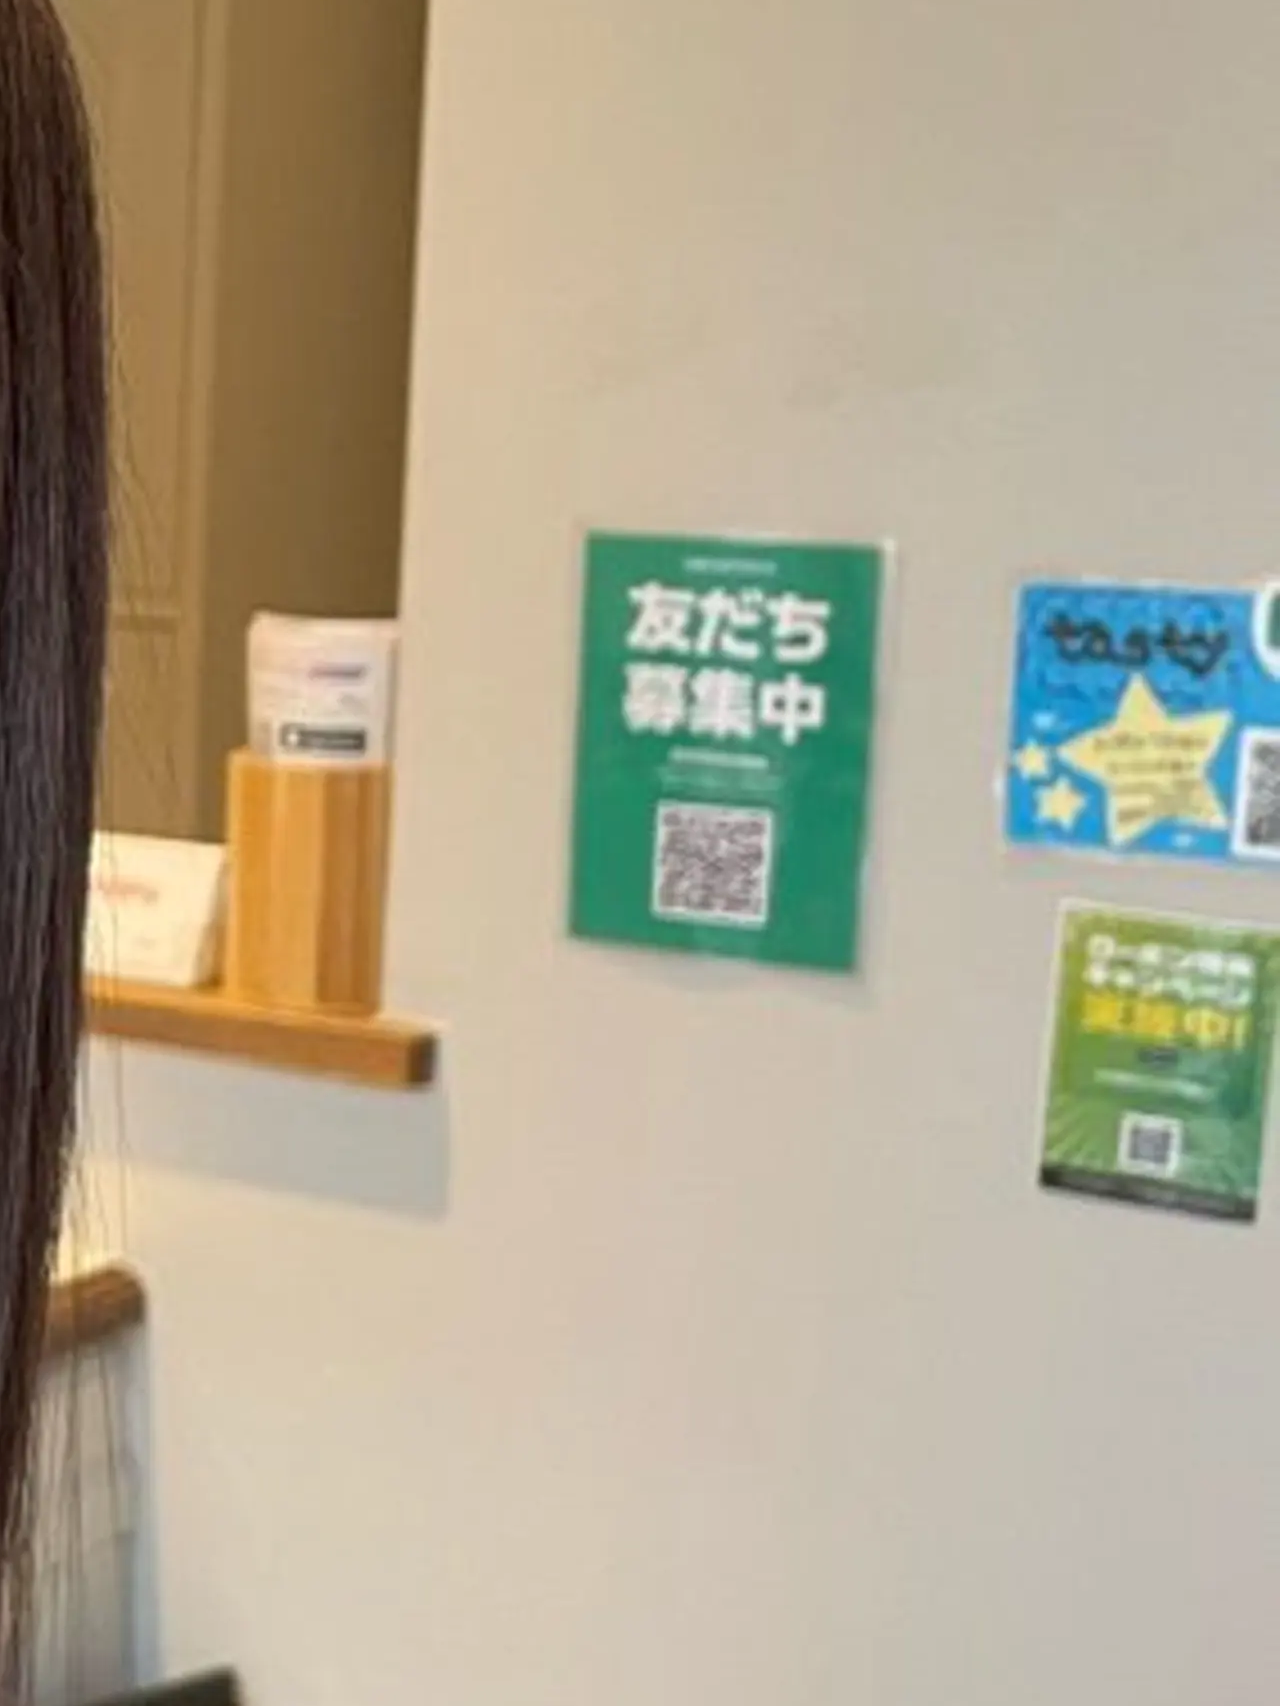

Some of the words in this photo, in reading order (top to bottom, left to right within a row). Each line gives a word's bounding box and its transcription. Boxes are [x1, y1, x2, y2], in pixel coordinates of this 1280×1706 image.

[627, 581, 831, 663] 友だち
[1044, 610, 1230, 677] tasty
[623, 662, 826, 746] 募集中
